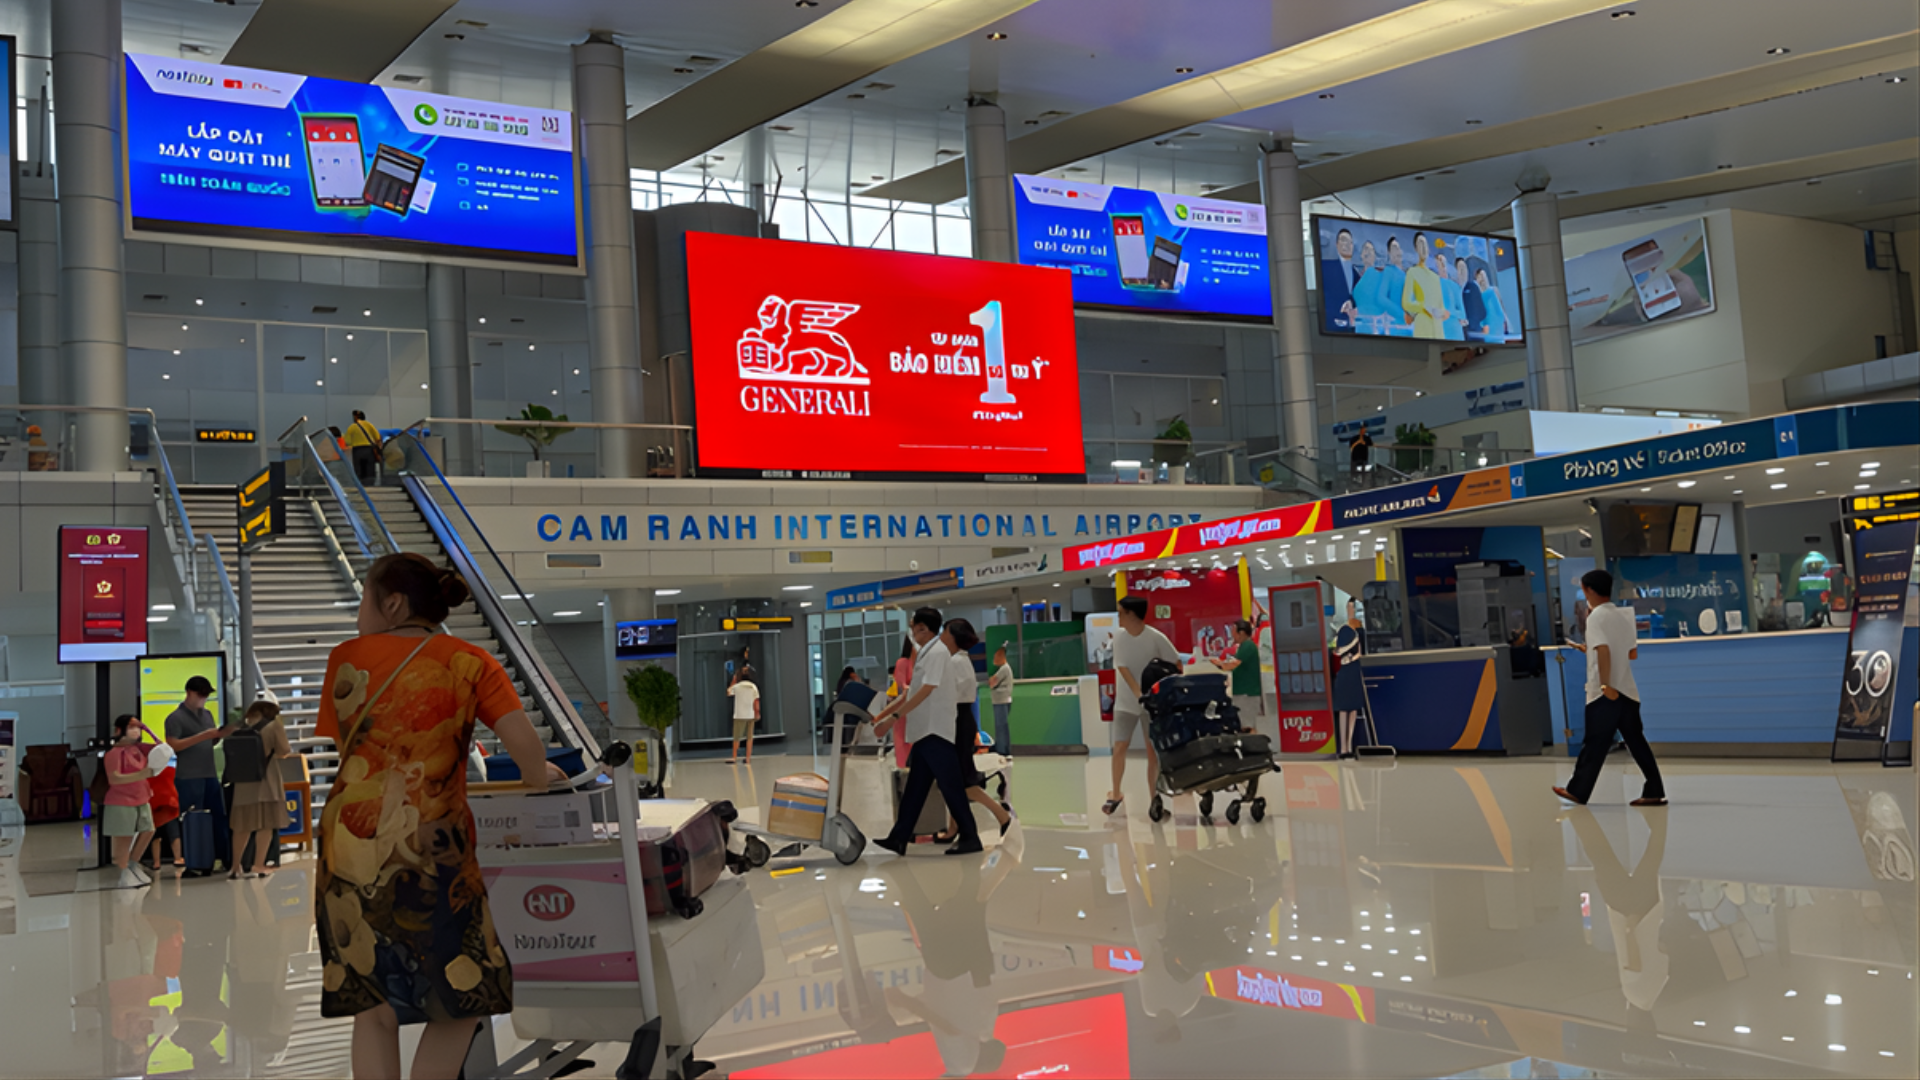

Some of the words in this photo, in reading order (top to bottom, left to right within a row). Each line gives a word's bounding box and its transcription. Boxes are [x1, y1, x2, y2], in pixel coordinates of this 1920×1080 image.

[739, 384, 871, 417] GENERALI
[537, 513, 628, 542] CAM
[647, 513, 757, 541] RANH
[774, 513, 1058, 541] INTERNATIONAL
